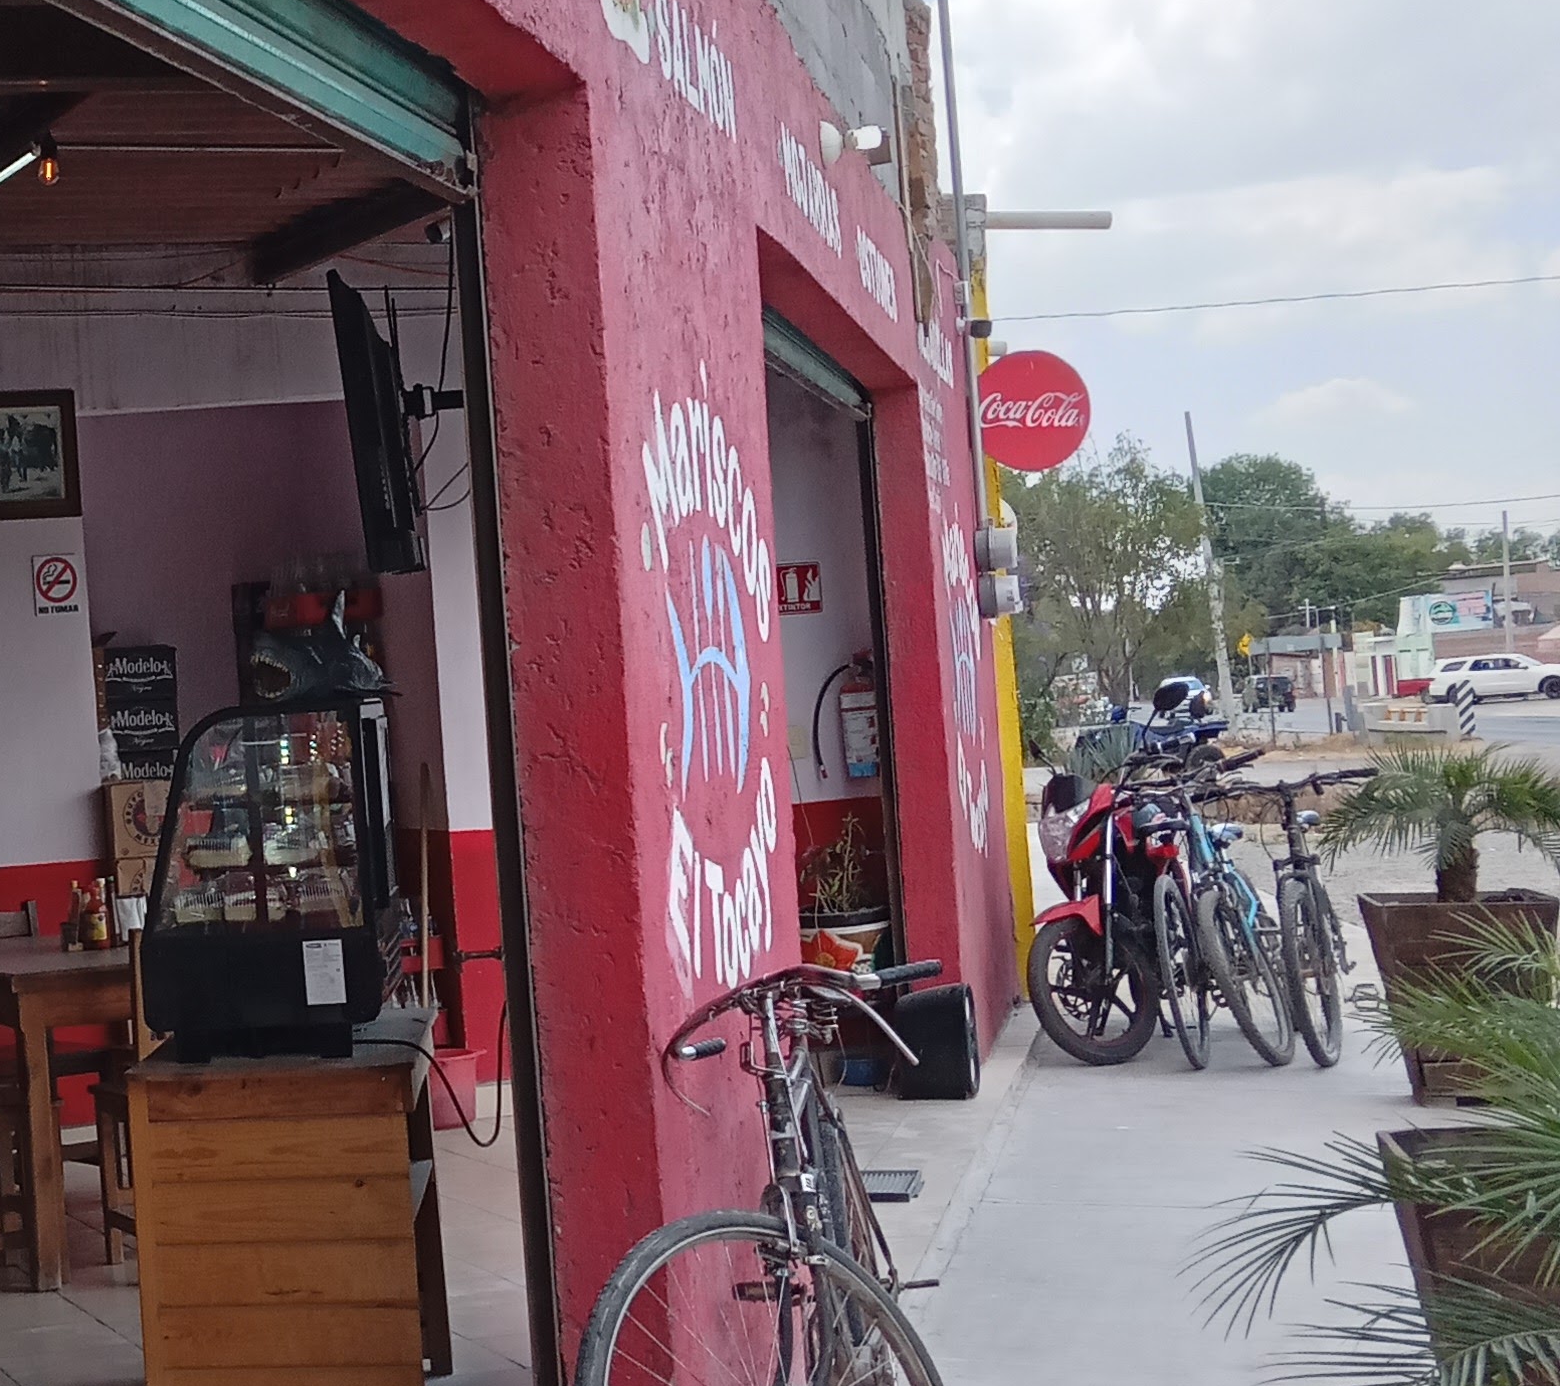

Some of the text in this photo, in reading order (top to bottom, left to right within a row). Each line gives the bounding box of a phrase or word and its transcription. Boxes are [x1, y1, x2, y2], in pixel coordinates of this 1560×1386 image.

[980, 392, 1085, 428] Coca-Cola
[642, 359, 770, 642] Mariscos
[115, 657, 161, 675] Modelo
[116, 709, 163, 728] Modelo
[121, 761, 169, 779] Modelo
[667, 757, 778, 990] El Tocayo
